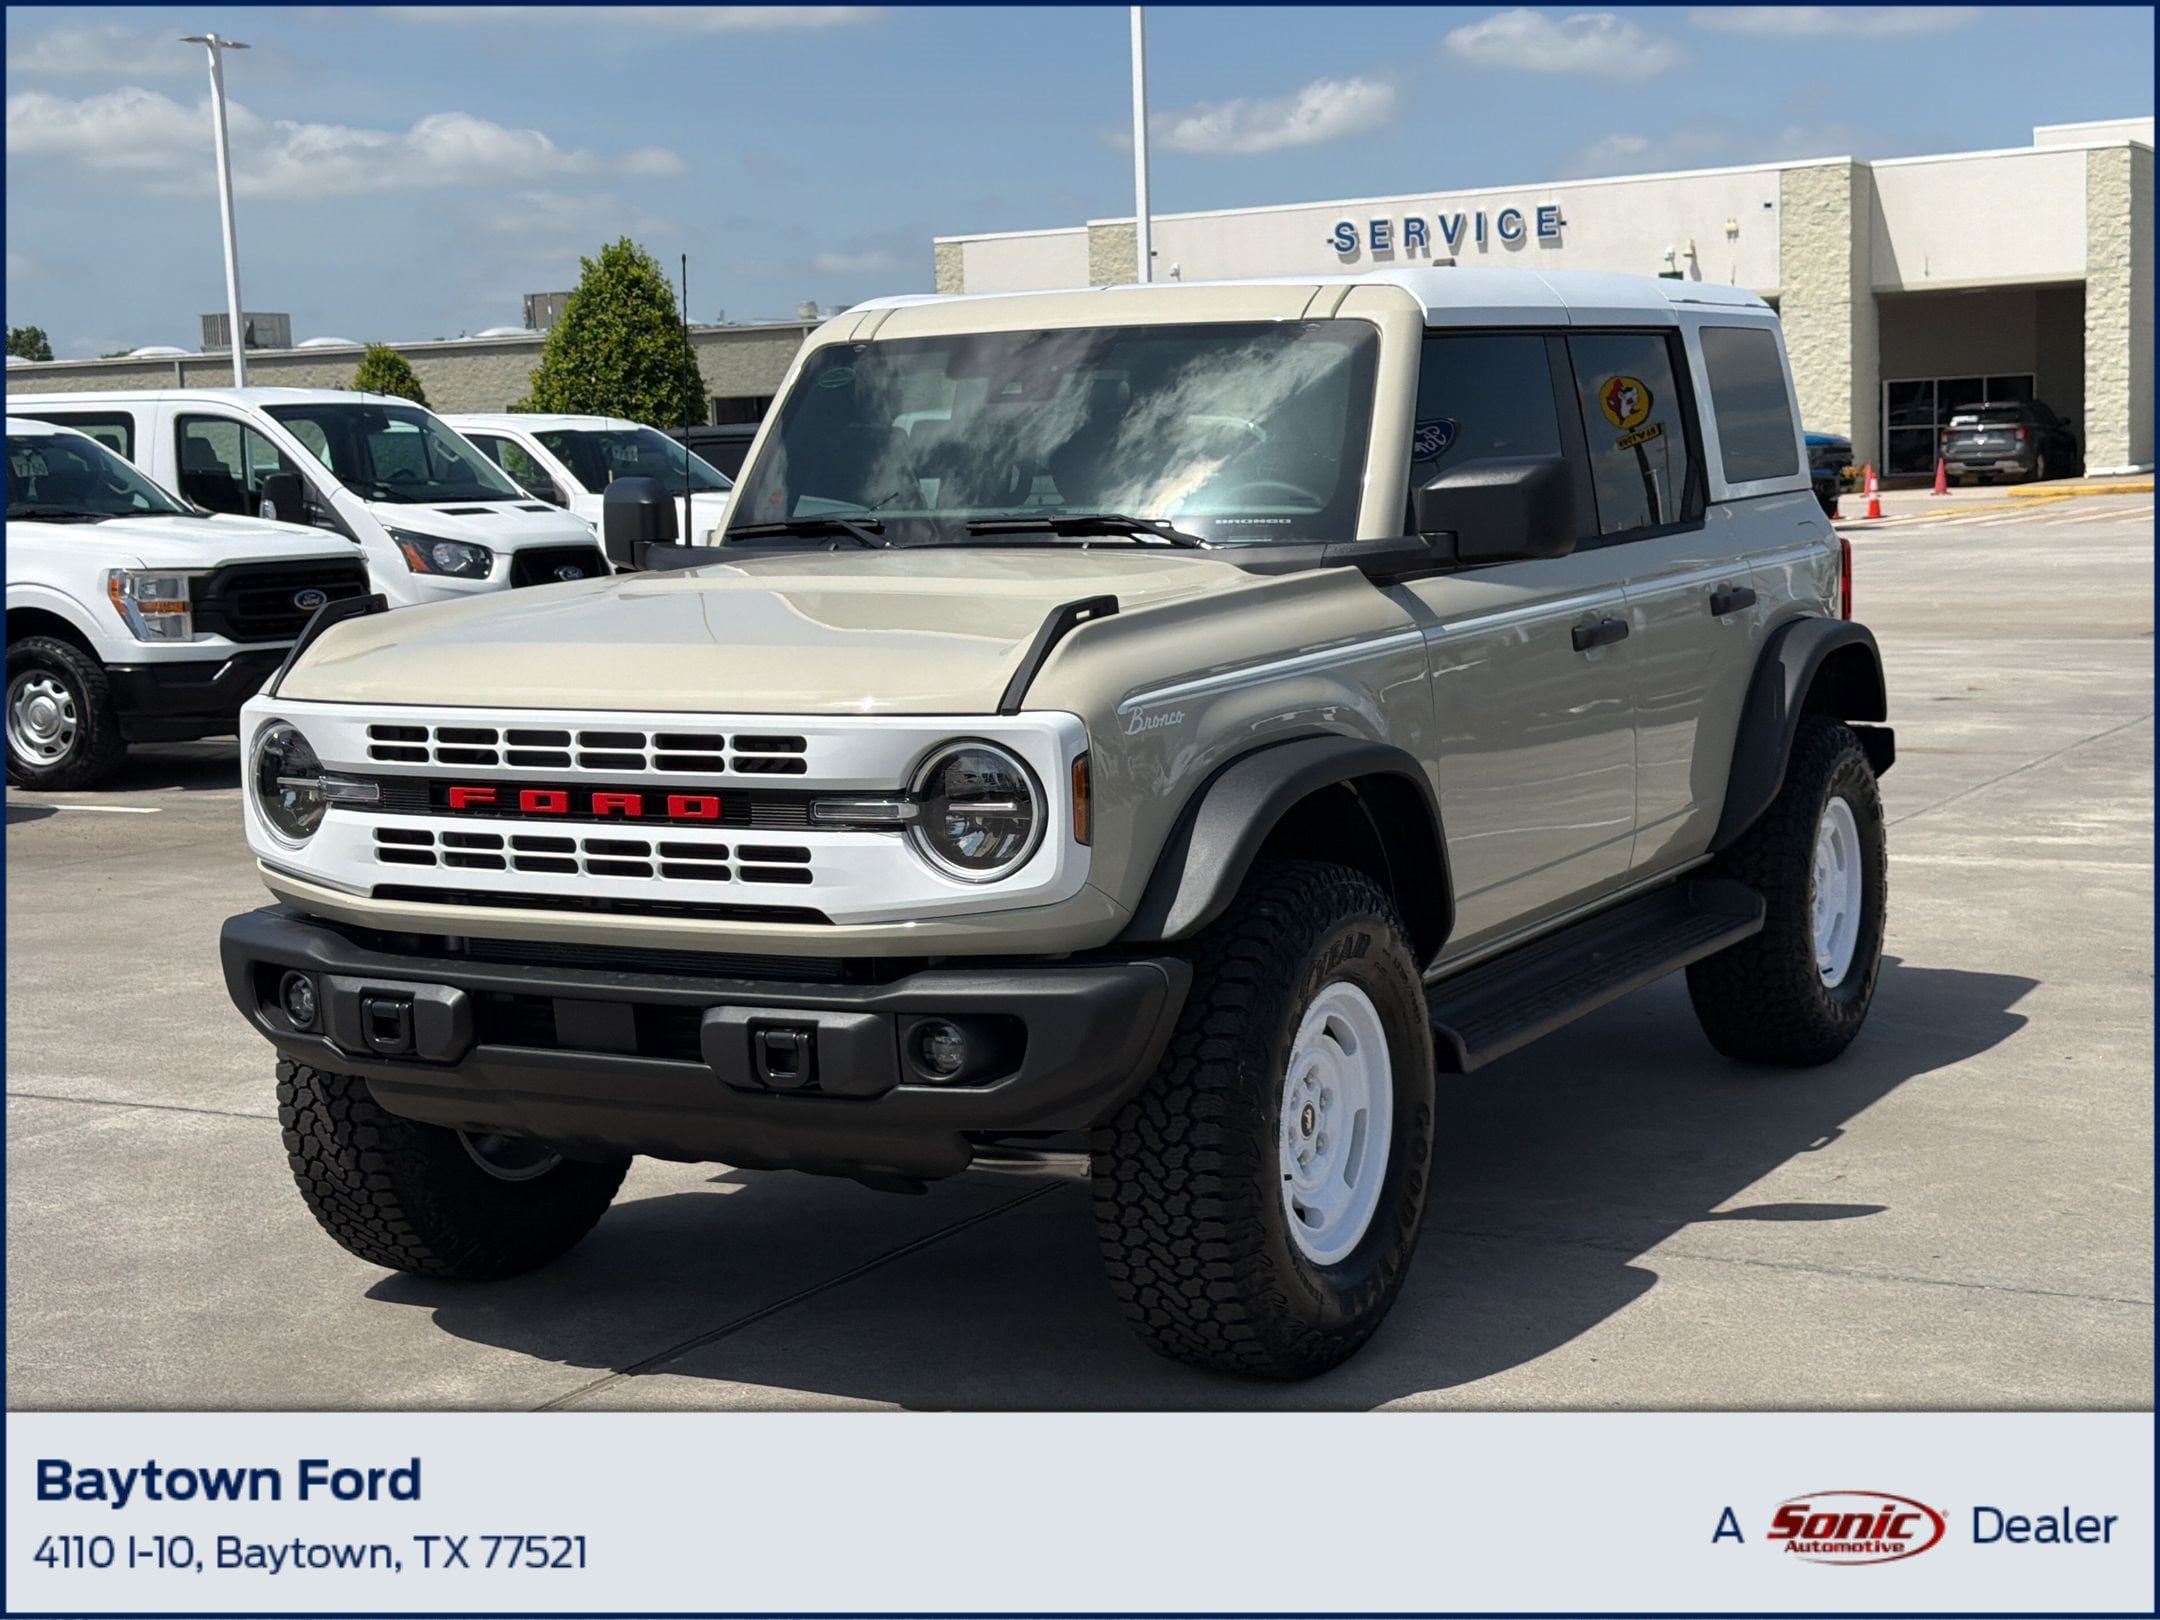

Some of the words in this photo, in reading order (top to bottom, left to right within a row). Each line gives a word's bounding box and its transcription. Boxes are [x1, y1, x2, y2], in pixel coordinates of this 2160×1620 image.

[1334, 205, 1559, 254] SERVICE
[1124, 705, 1185, 735] Bronco
[450, 786, 720, 818] FORD
